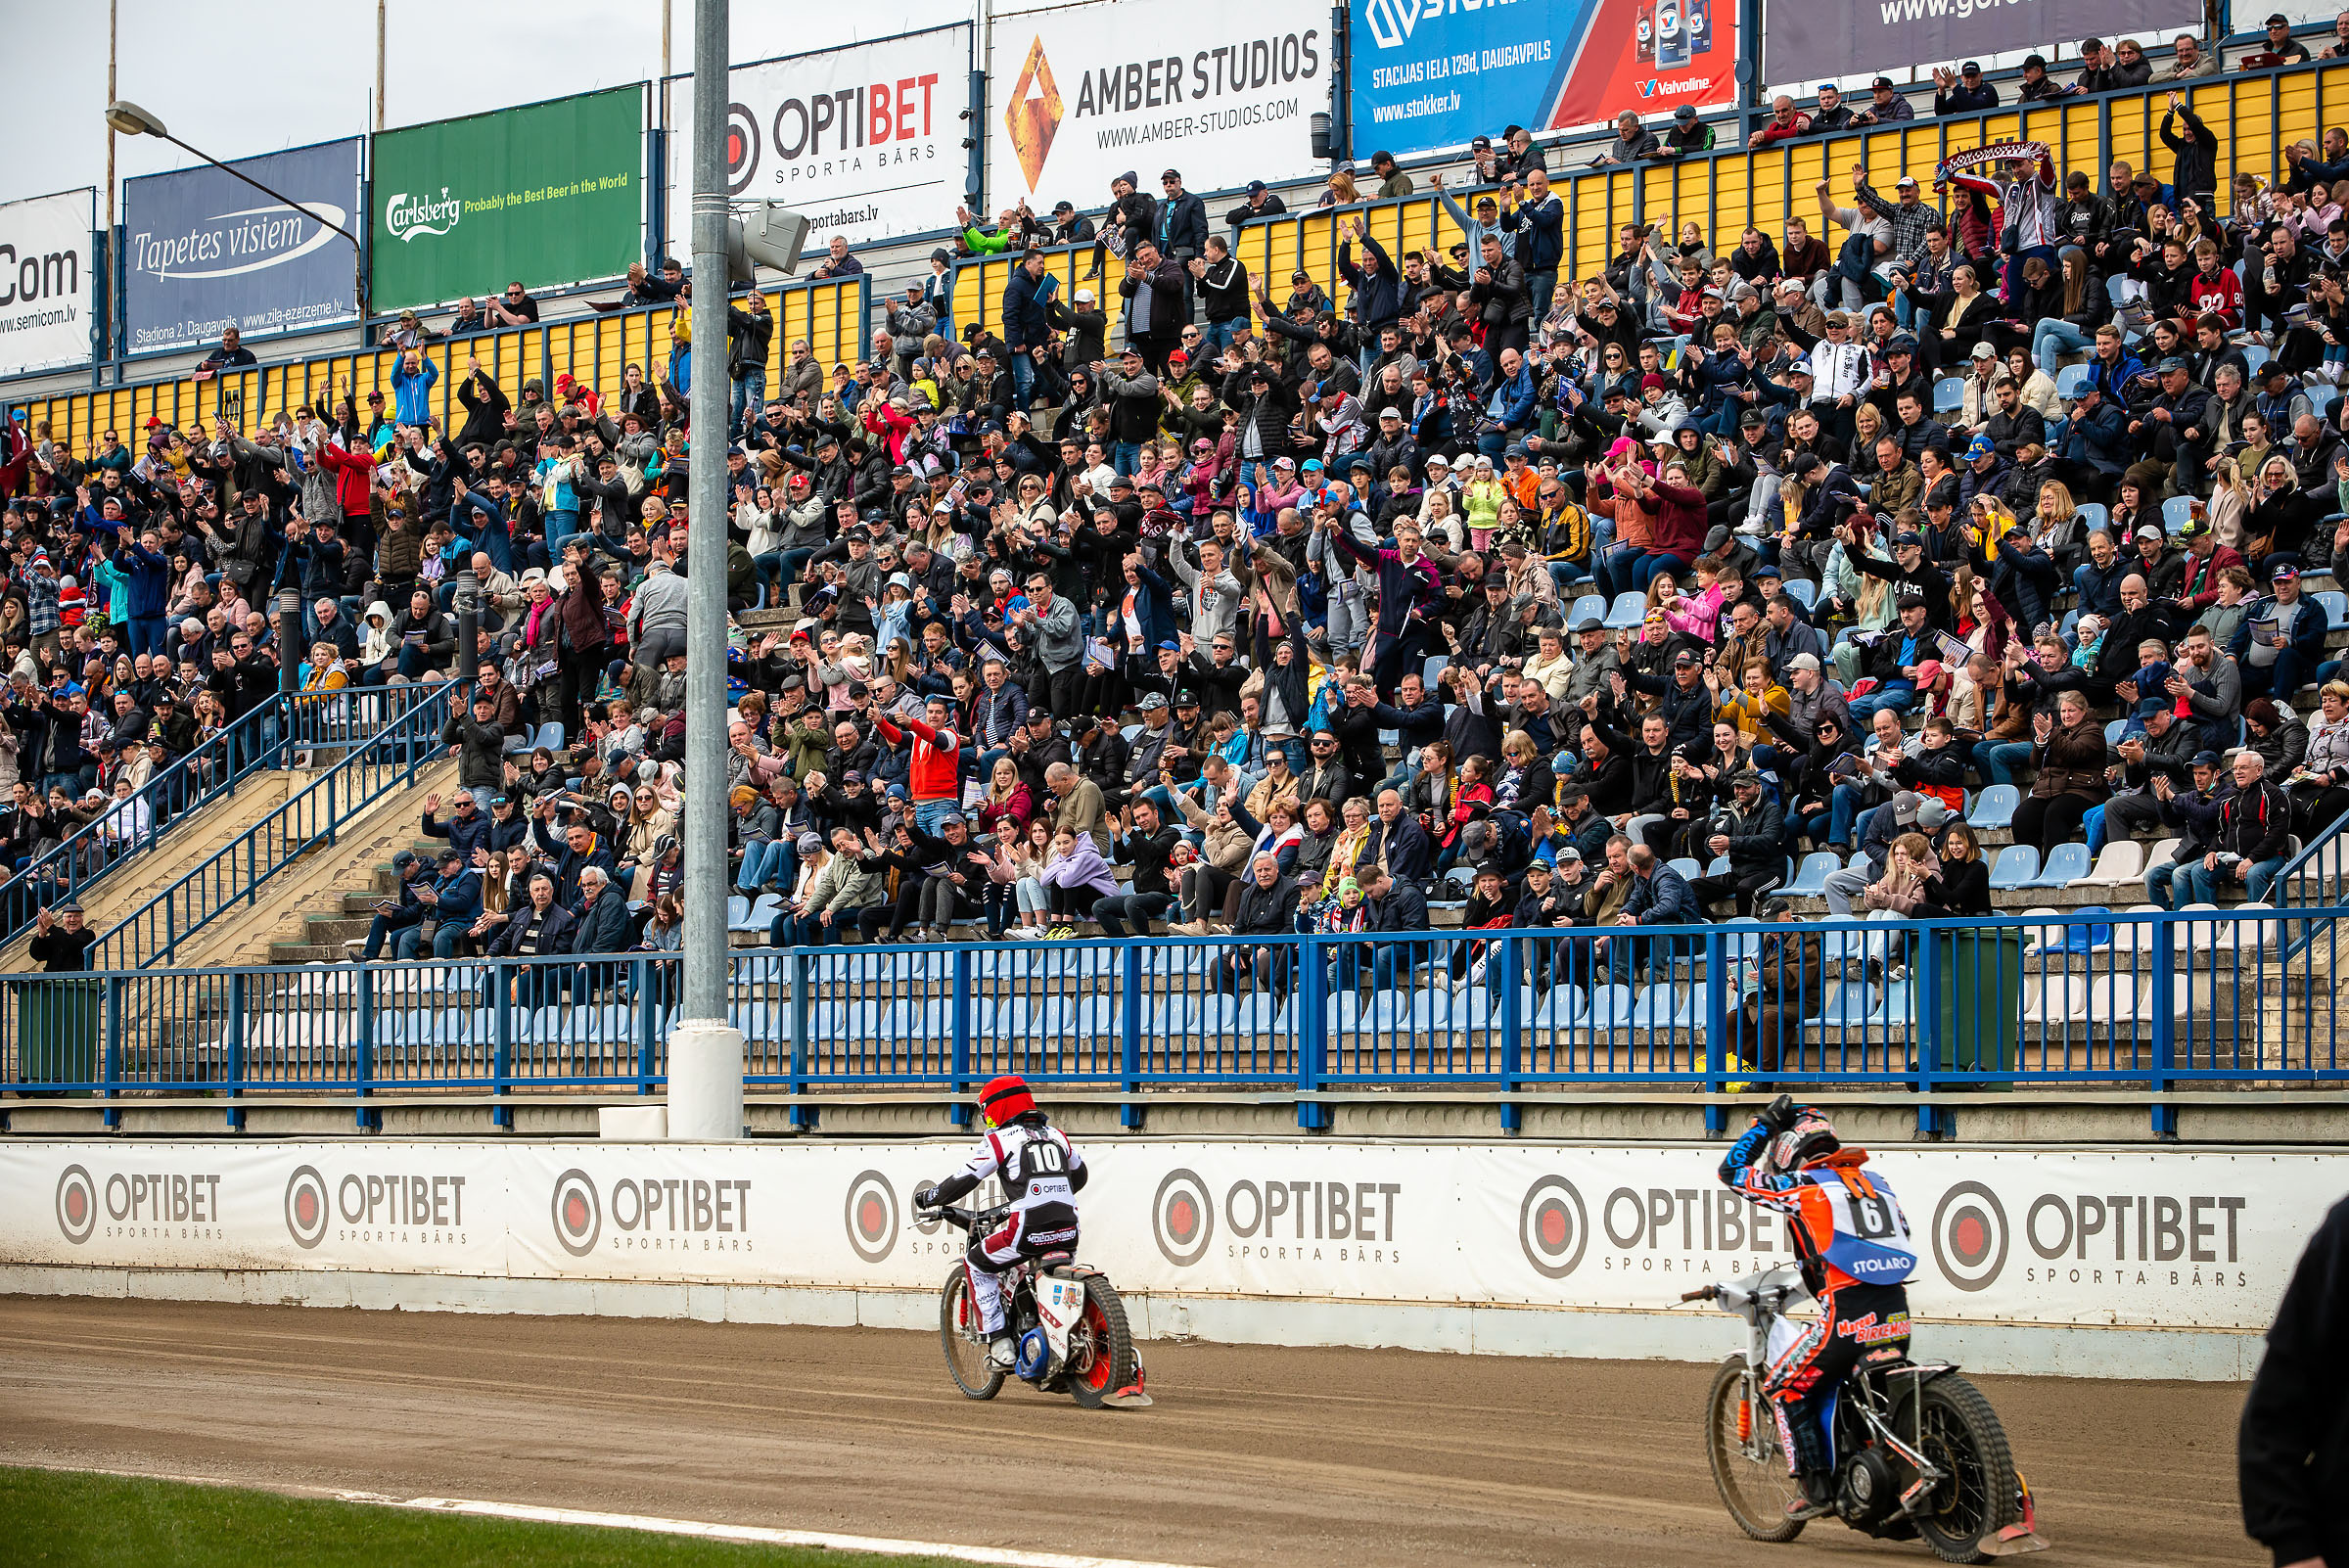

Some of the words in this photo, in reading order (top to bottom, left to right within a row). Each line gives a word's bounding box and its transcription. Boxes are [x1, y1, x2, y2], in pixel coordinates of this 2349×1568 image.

[1075, 56, 1183, 118] AMBER
[1191, 29, 1318, 100] STUDIOS
[1373, 62, 1424, 89] STACIJAS
[1426, 57, 1451, 80] IELA
[1482, 39, 1551, 70] DAUGAVPILS
[773, 72, 939, 160] OPTIBET
[1097, 98, 1299, 149] WWW.AMBER-STUDIOS.COM
[1373, 89, 1461, 123] www.stokker.lv
[775, 157, 862, 184] SPORTA
[879, 144, 935, 167] BĀRS
[386, 191, 461, 241] Carlsberg
[464, 194, 505, 213] Probably
[507, 191, 523, 207] the
[525, 187, 545, 204] Best
[547, 186, 570, 200] Beer
[571, 182, 579, 195] in
[580, 179, 597, 193] the
[599, 172, 628, 190] World
[807, 204, 879, 234] portabars.lv
[135, 228, 222, 282] Tapetes
[229, 215, 302, 256] visiem
[136, 324, 175, 344] Stadiona
[188, 315, 237, 338] Daugavpils
[244, 298, 343, 325] www.zila-ezerzeme.lv
[1028, 1143, 1062, 1173] 10
[106, 1173, 221, 1222] OPTIBET
[339, 1174, 466, 1226] OPTIBET
[611, 1177, 753, 1233] OPTIBET
[1042, 1183, 1069, 1194] OPTIBET
[1225, 1179, 1402, 1242] OPTIBET
[1860, 1198, 1884, 1233] 6
[2026, 1193, 2246, 1263] OPTIBET
[107, 1226, 170, 1240] SPORTA
[181, 1224, 223, 1240] BĀRS
[340, 1230, 408, 1244] SPORTA
[421, 1229, 467, 1245] BĀRS
[614, 1237, 690, 1252] SPORTA
[704, 1236, 754, 1253] BĀRS
[912, 1242, 966, 1255] SPOR
[1228, 1245, 1322, 1261] SPORTA
[1340, 1245, 1400, 1264] BĀRS
[1604, 1256, 1711, 1273] SPORTA
[1853, 1256, 1910, 1274] STOLARO
[2027, 1268, 2146, 1285] SPORTA
[2170, 1265, 2246, 1287] BĀRS
[1837, 1312, 1878, 1338] Marcus
